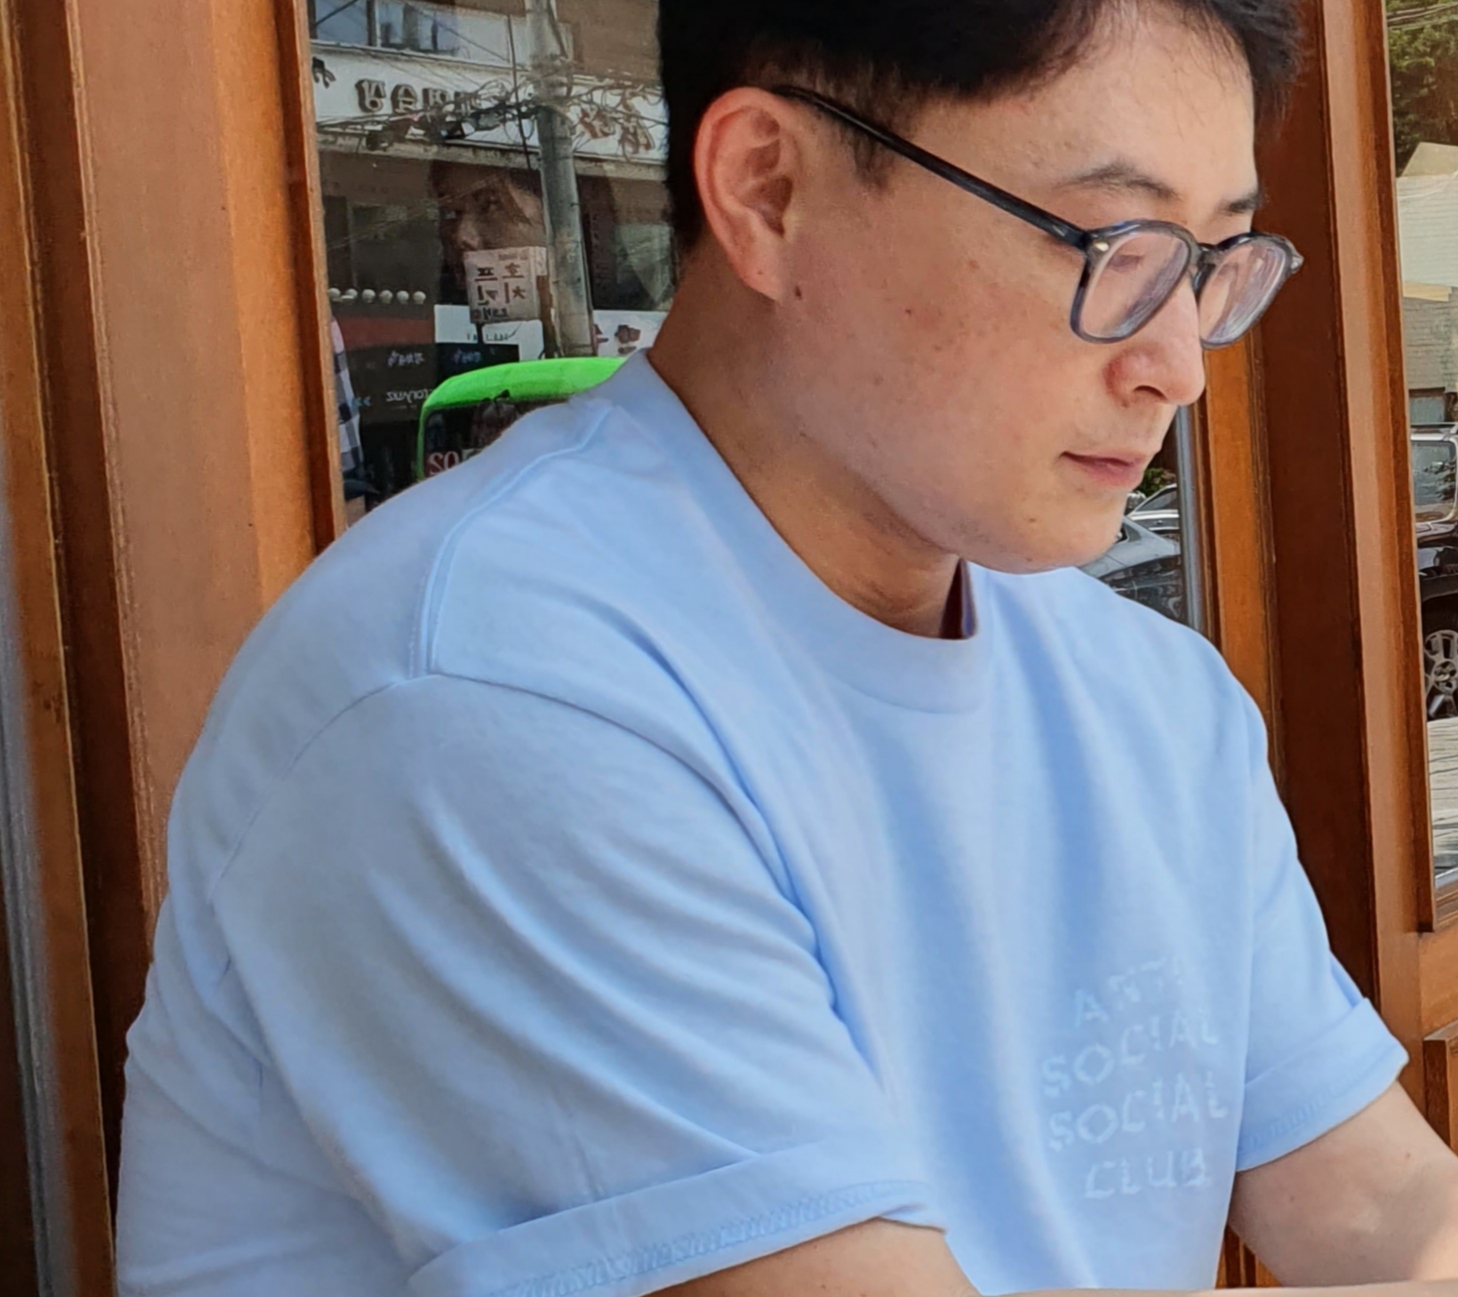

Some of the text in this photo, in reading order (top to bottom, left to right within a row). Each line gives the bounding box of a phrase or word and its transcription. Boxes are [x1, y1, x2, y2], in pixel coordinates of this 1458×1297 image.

[1041, 1007, 1220, 1099] SOCIAL
[1048, 1069, 1229, 1153] SOCIAL
[1084, 1148, 1213, 1200] CLUB
